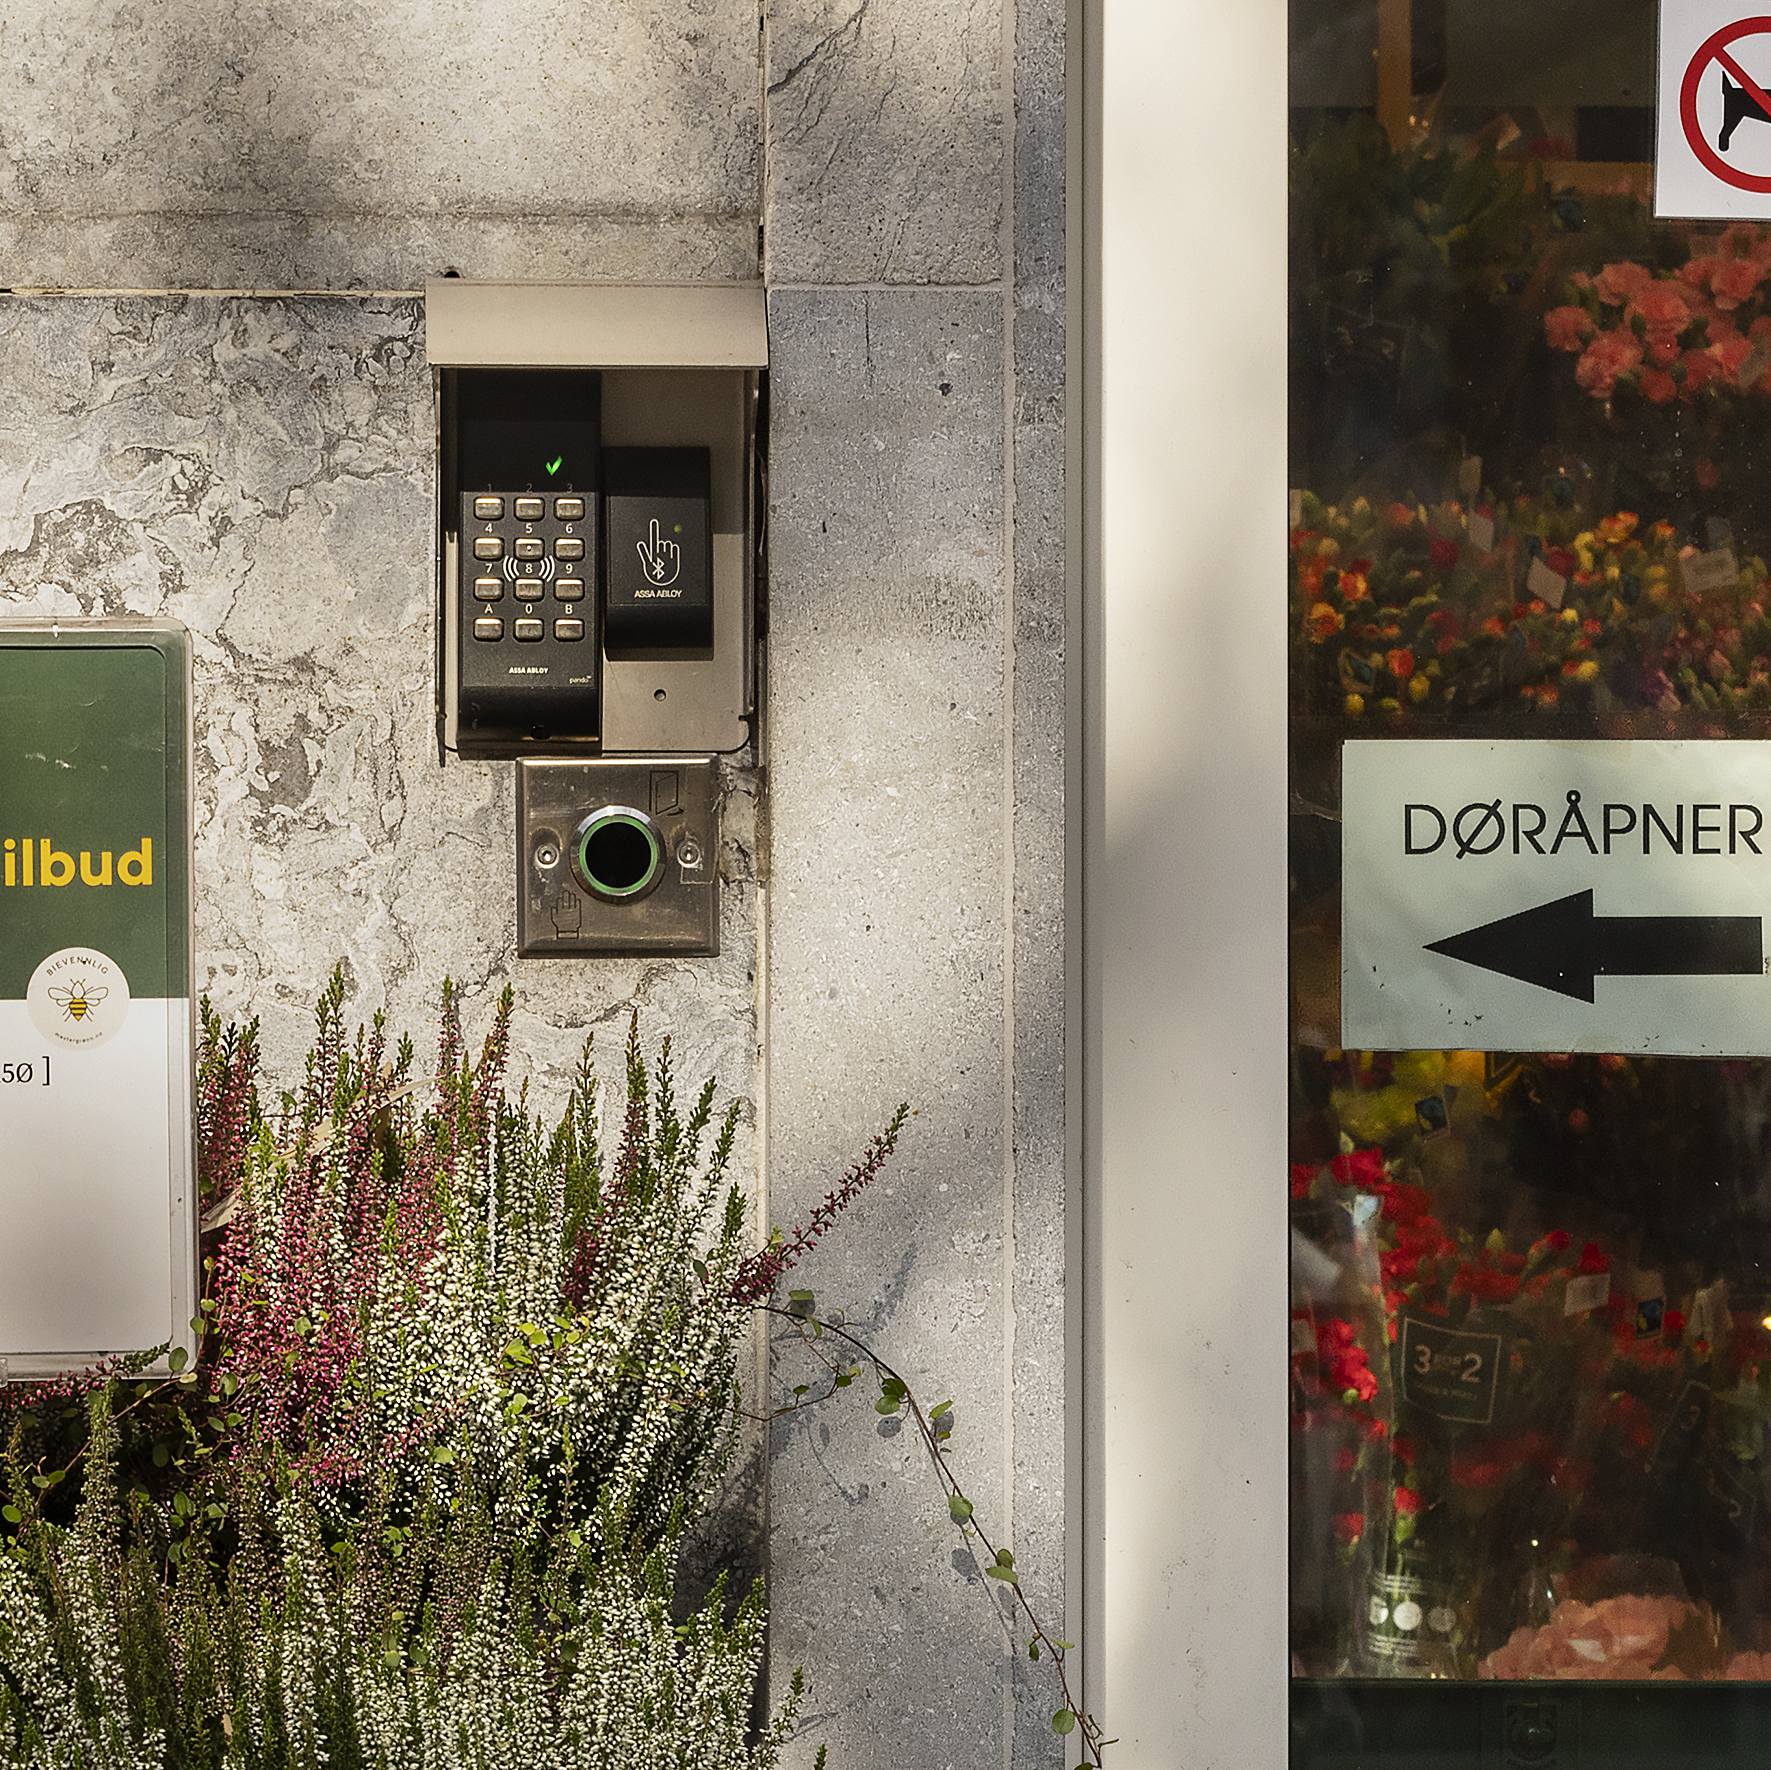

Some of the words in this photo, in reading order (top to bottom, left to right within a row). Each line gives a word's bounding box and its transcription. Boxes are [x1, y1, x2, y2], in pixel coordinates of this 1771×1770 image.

[485, 523, 493, 533] 4
[526, 523, 532, 533] 5
[566, 523, 573, 533] 6
[485, 564, 492, 573] 7
[526, 563, 532, 573] 8
[566, 564, 573, 573] 9
[634, 590, 655, 598] ASSA
[656, 590, 682, 598] ABLOY
[485, 604, 493, 614] A
[565, 604, 573, 614] B
[1405, 790, 1763, 860] DØRÅPNER
[46, 956, 109, 976] BIEVENNLIG
[1413, 1344, 1431, 1374] 3
[1461, 1353, 1482, 1382] 2
